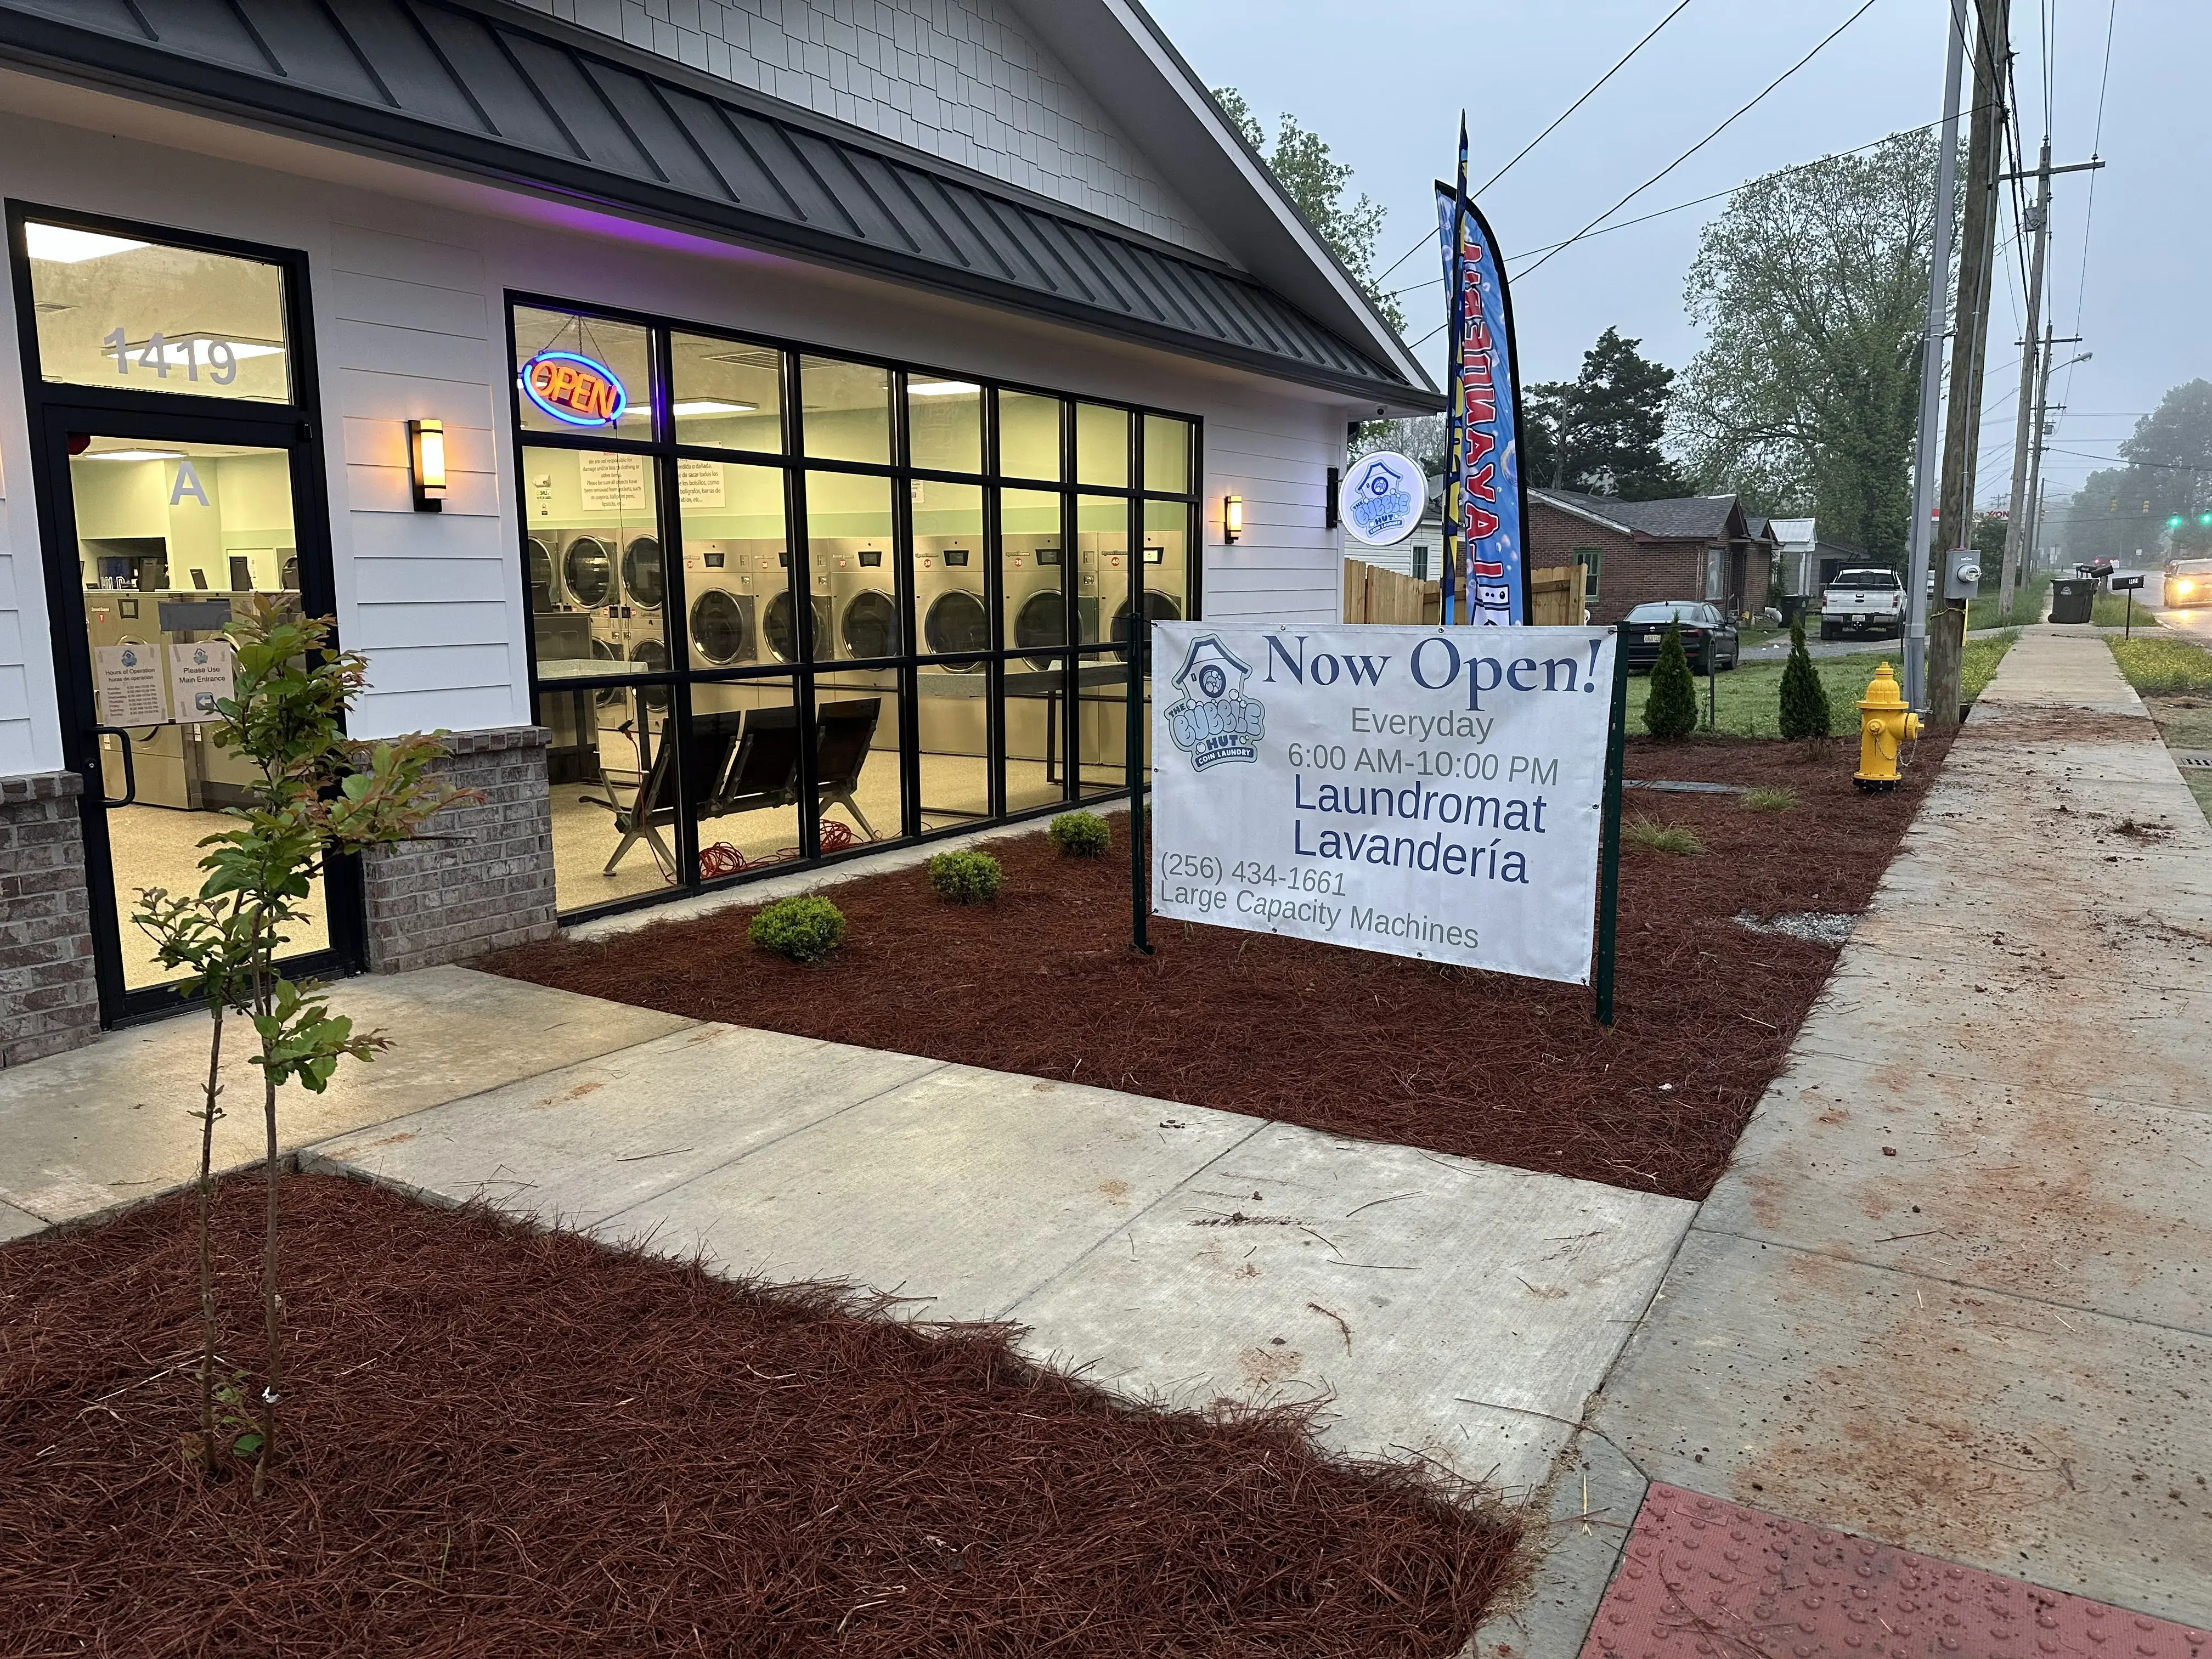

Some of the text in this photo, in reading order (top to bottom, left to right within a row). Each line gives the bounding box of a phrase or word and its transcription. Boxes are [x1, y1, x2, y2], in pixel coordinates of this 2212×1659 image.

[104, 328, 236, 385] 1419
[531, 360, 618, 418] OPEN
[170, 461, 210, 506] A
[1353, 501, 1363, 509] THE
[1356, 494, 1409, 524] BUBBLE
[1370, 521, 1401, 533] COIN LAUNDRY
[1375, 514, 1393, 524] HUT
[1262, 635, 1602, 712] Now Open!
[1169, 703, 1187, 718] THE
[1173, 699, 1262, 747] BUBBLE
[1352, 707, 1493, 744] Everyday
[1198, 749, 1251, 764] COIN LAUNDRY
[1206, 735, 1238, 751] HUT
[1289, 743, 1559, 786] 6:00 AM-10:00 PM
[1295, 774, 1547, 833] Laundromat
[1161, 851, 1346, 896] (256) 434-1661
[1295, 820, 1530, 884] Lavandería
[1161, 881, 1479, 949] Large Capacity Machines
